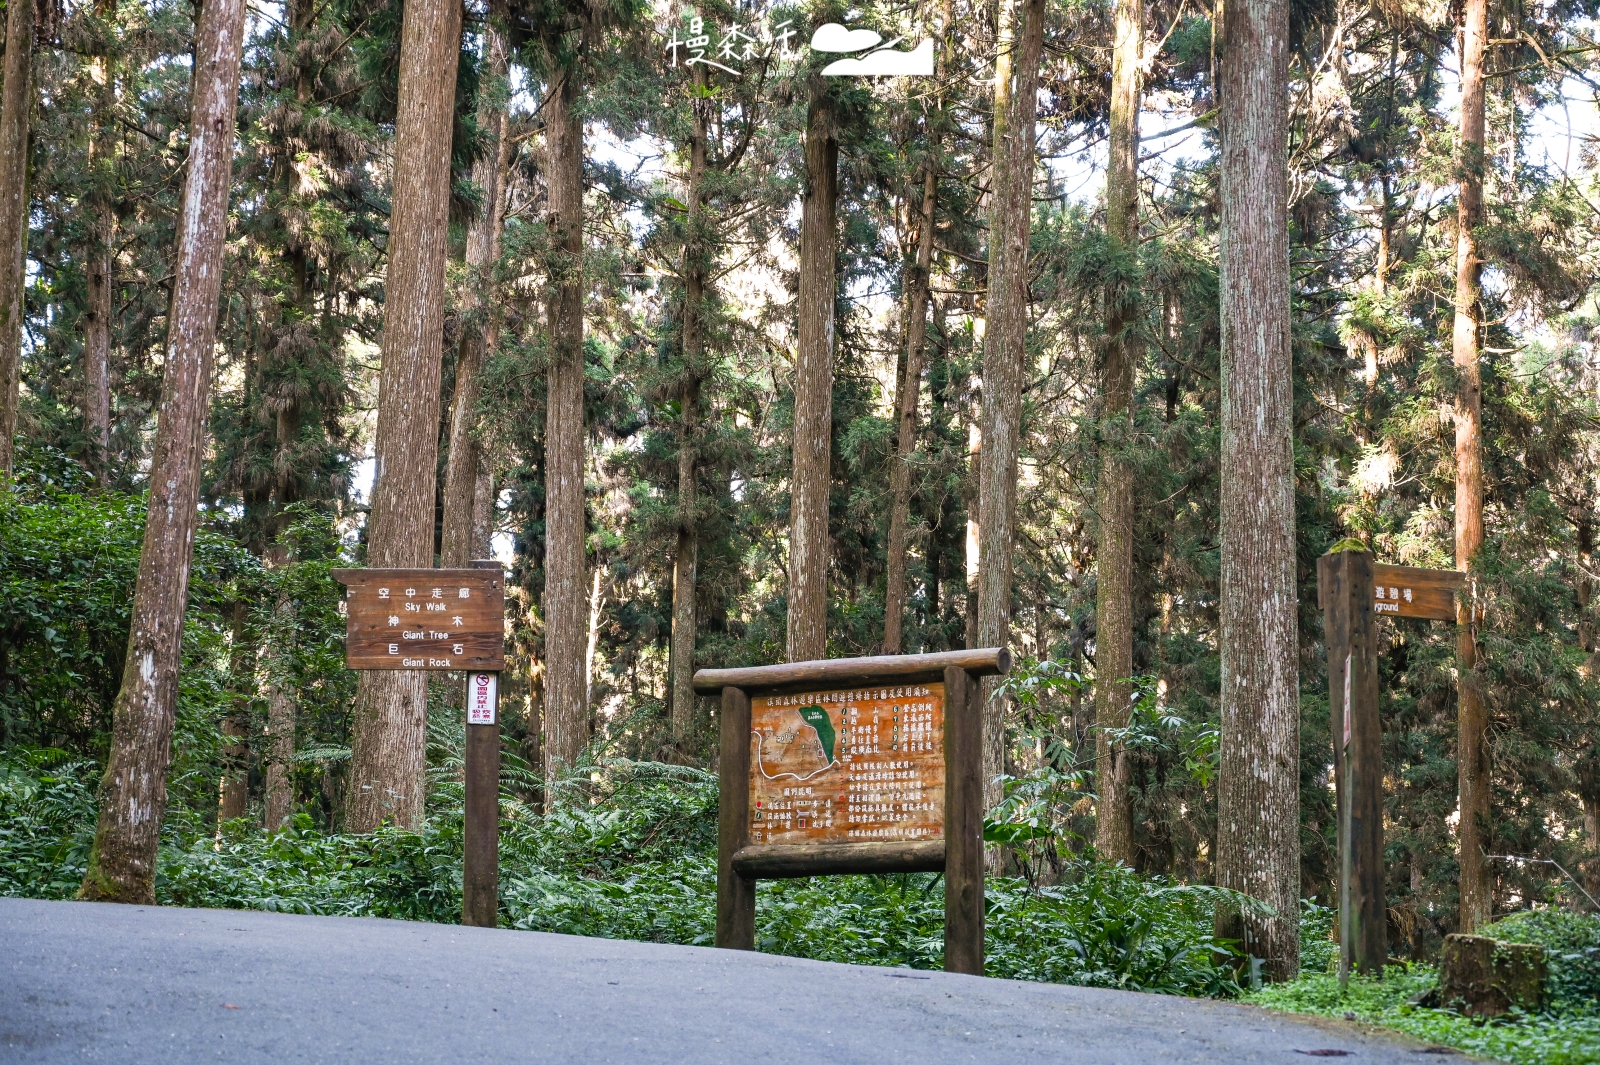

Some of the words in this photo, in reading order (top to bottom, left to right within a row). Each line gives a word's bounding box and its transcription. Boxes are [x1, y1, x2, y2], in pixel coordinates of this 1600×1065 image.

[378, 587, 470, 599] 空中走廊
[405, 602, 420, 612] Sky
[426, 602, 446, 612] Walk
[388, 615, 463, 627] 神木
[402, 630, 424, 640] Giant
[428, 630, 448, 640] Tree
[388, 643, 464, 655] 巨石
[402, 658, 424, 667] Giant
[429, 658, 451, 667] Rock
